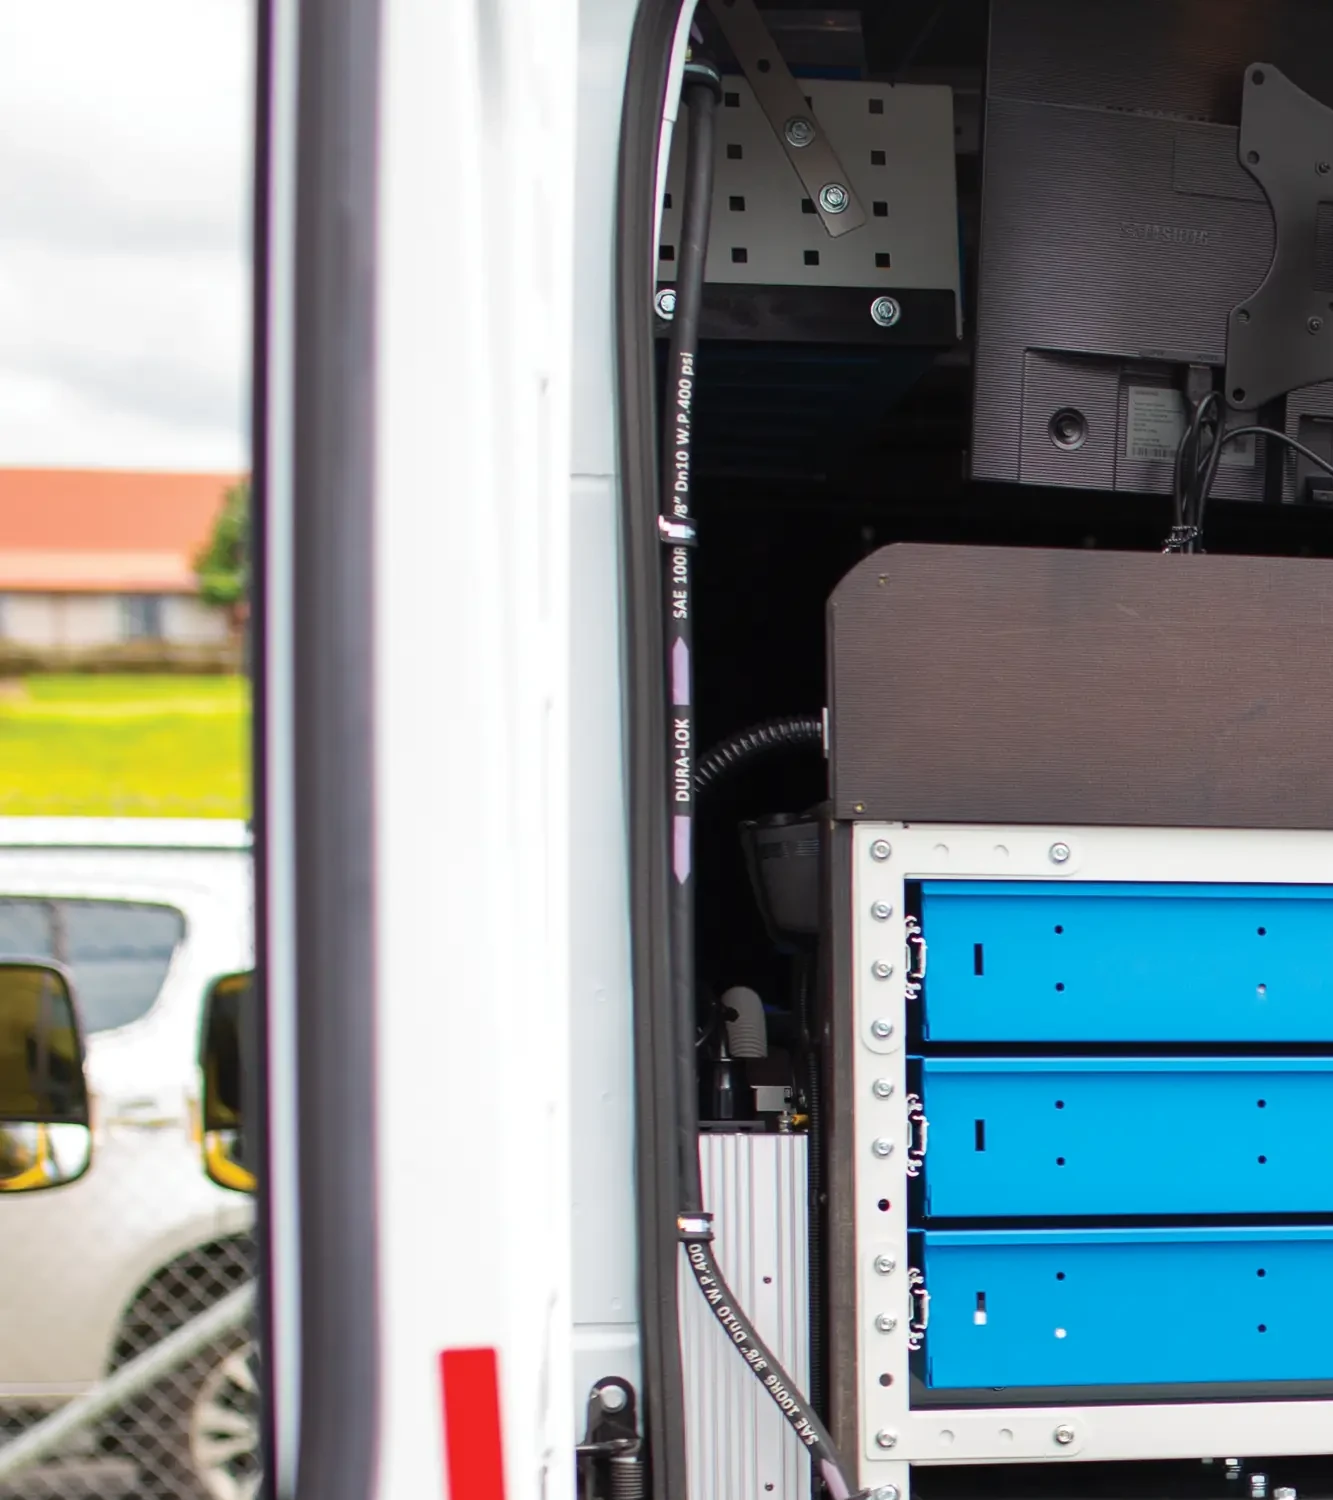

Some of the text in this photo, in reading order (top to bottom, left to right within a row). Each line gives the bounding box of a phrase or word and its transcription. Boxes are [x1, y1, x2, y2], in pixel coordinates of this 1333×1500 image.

[679, 352, 695, 376] psi
[675, 379, 692, 445] W.P.400
[675, 451, 690, 492] Dn10
[673, 547, 688, 585] 100R
[672, 590, 688, 619] SAE
[673, 718, 690, 803] DURA-LOK
[687, 1243, 723, 1305] W.P.400
[715, 1305, 747, 1343] Dn10
[763, 1372, 802, 1416] 100R6
[794, 1417, 819, 1447] SAE
